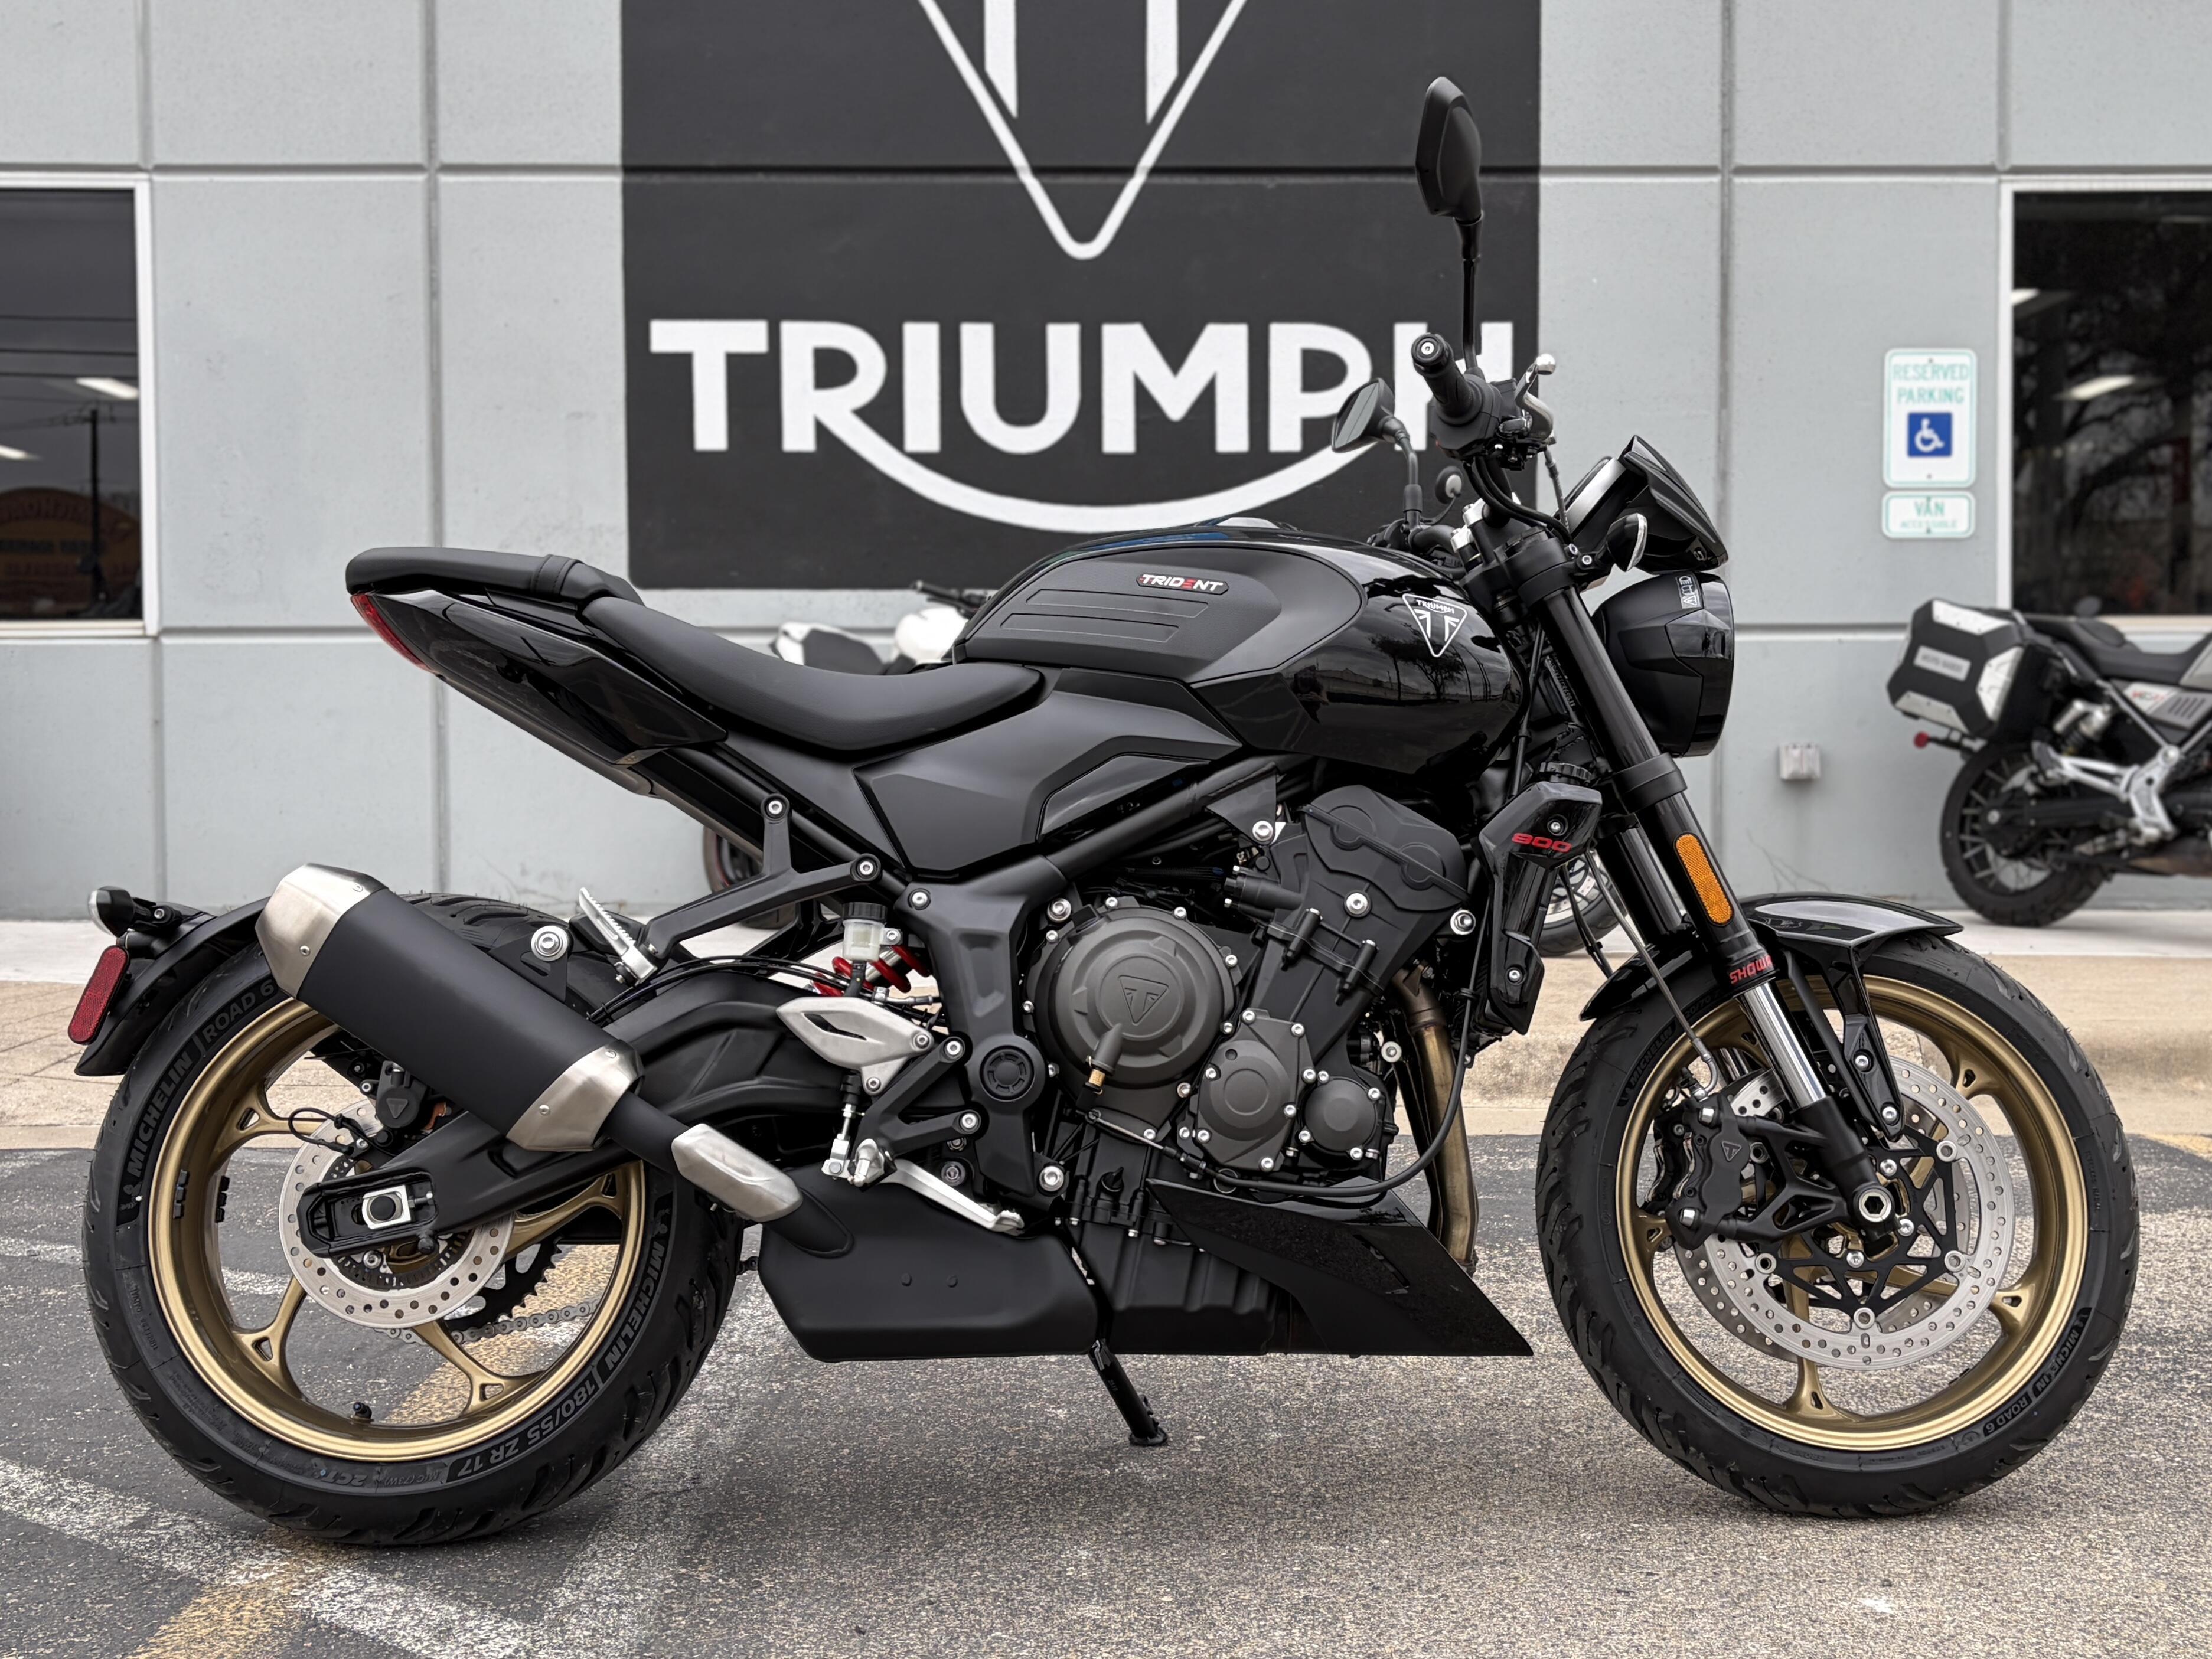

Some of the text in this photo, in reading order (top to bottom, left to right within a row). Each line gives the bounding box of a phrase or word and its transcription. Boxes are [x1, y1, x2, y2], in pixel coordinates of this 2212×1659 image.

[1893, 364, 1969, 380] RESERVED
[1897, 387, 1965, 404] PARKING
[1914, 501, 1945, 517] VAN
[1142, 574, 1223, 591] TRIDENT
[1416, 599, 1454, 614] TRIUMPH
[1512, 832, 1572, 853] 800
[1630, 995, 1711, 1087] MICHELIN 20/70
[126, 979, 275, 1177] MICHELIN ROAD 6
[458, 1243, 665, 1477] MICHELIN 180/55 ZR 17
[1986, 1391, 2029, 1433] ROAD 6
